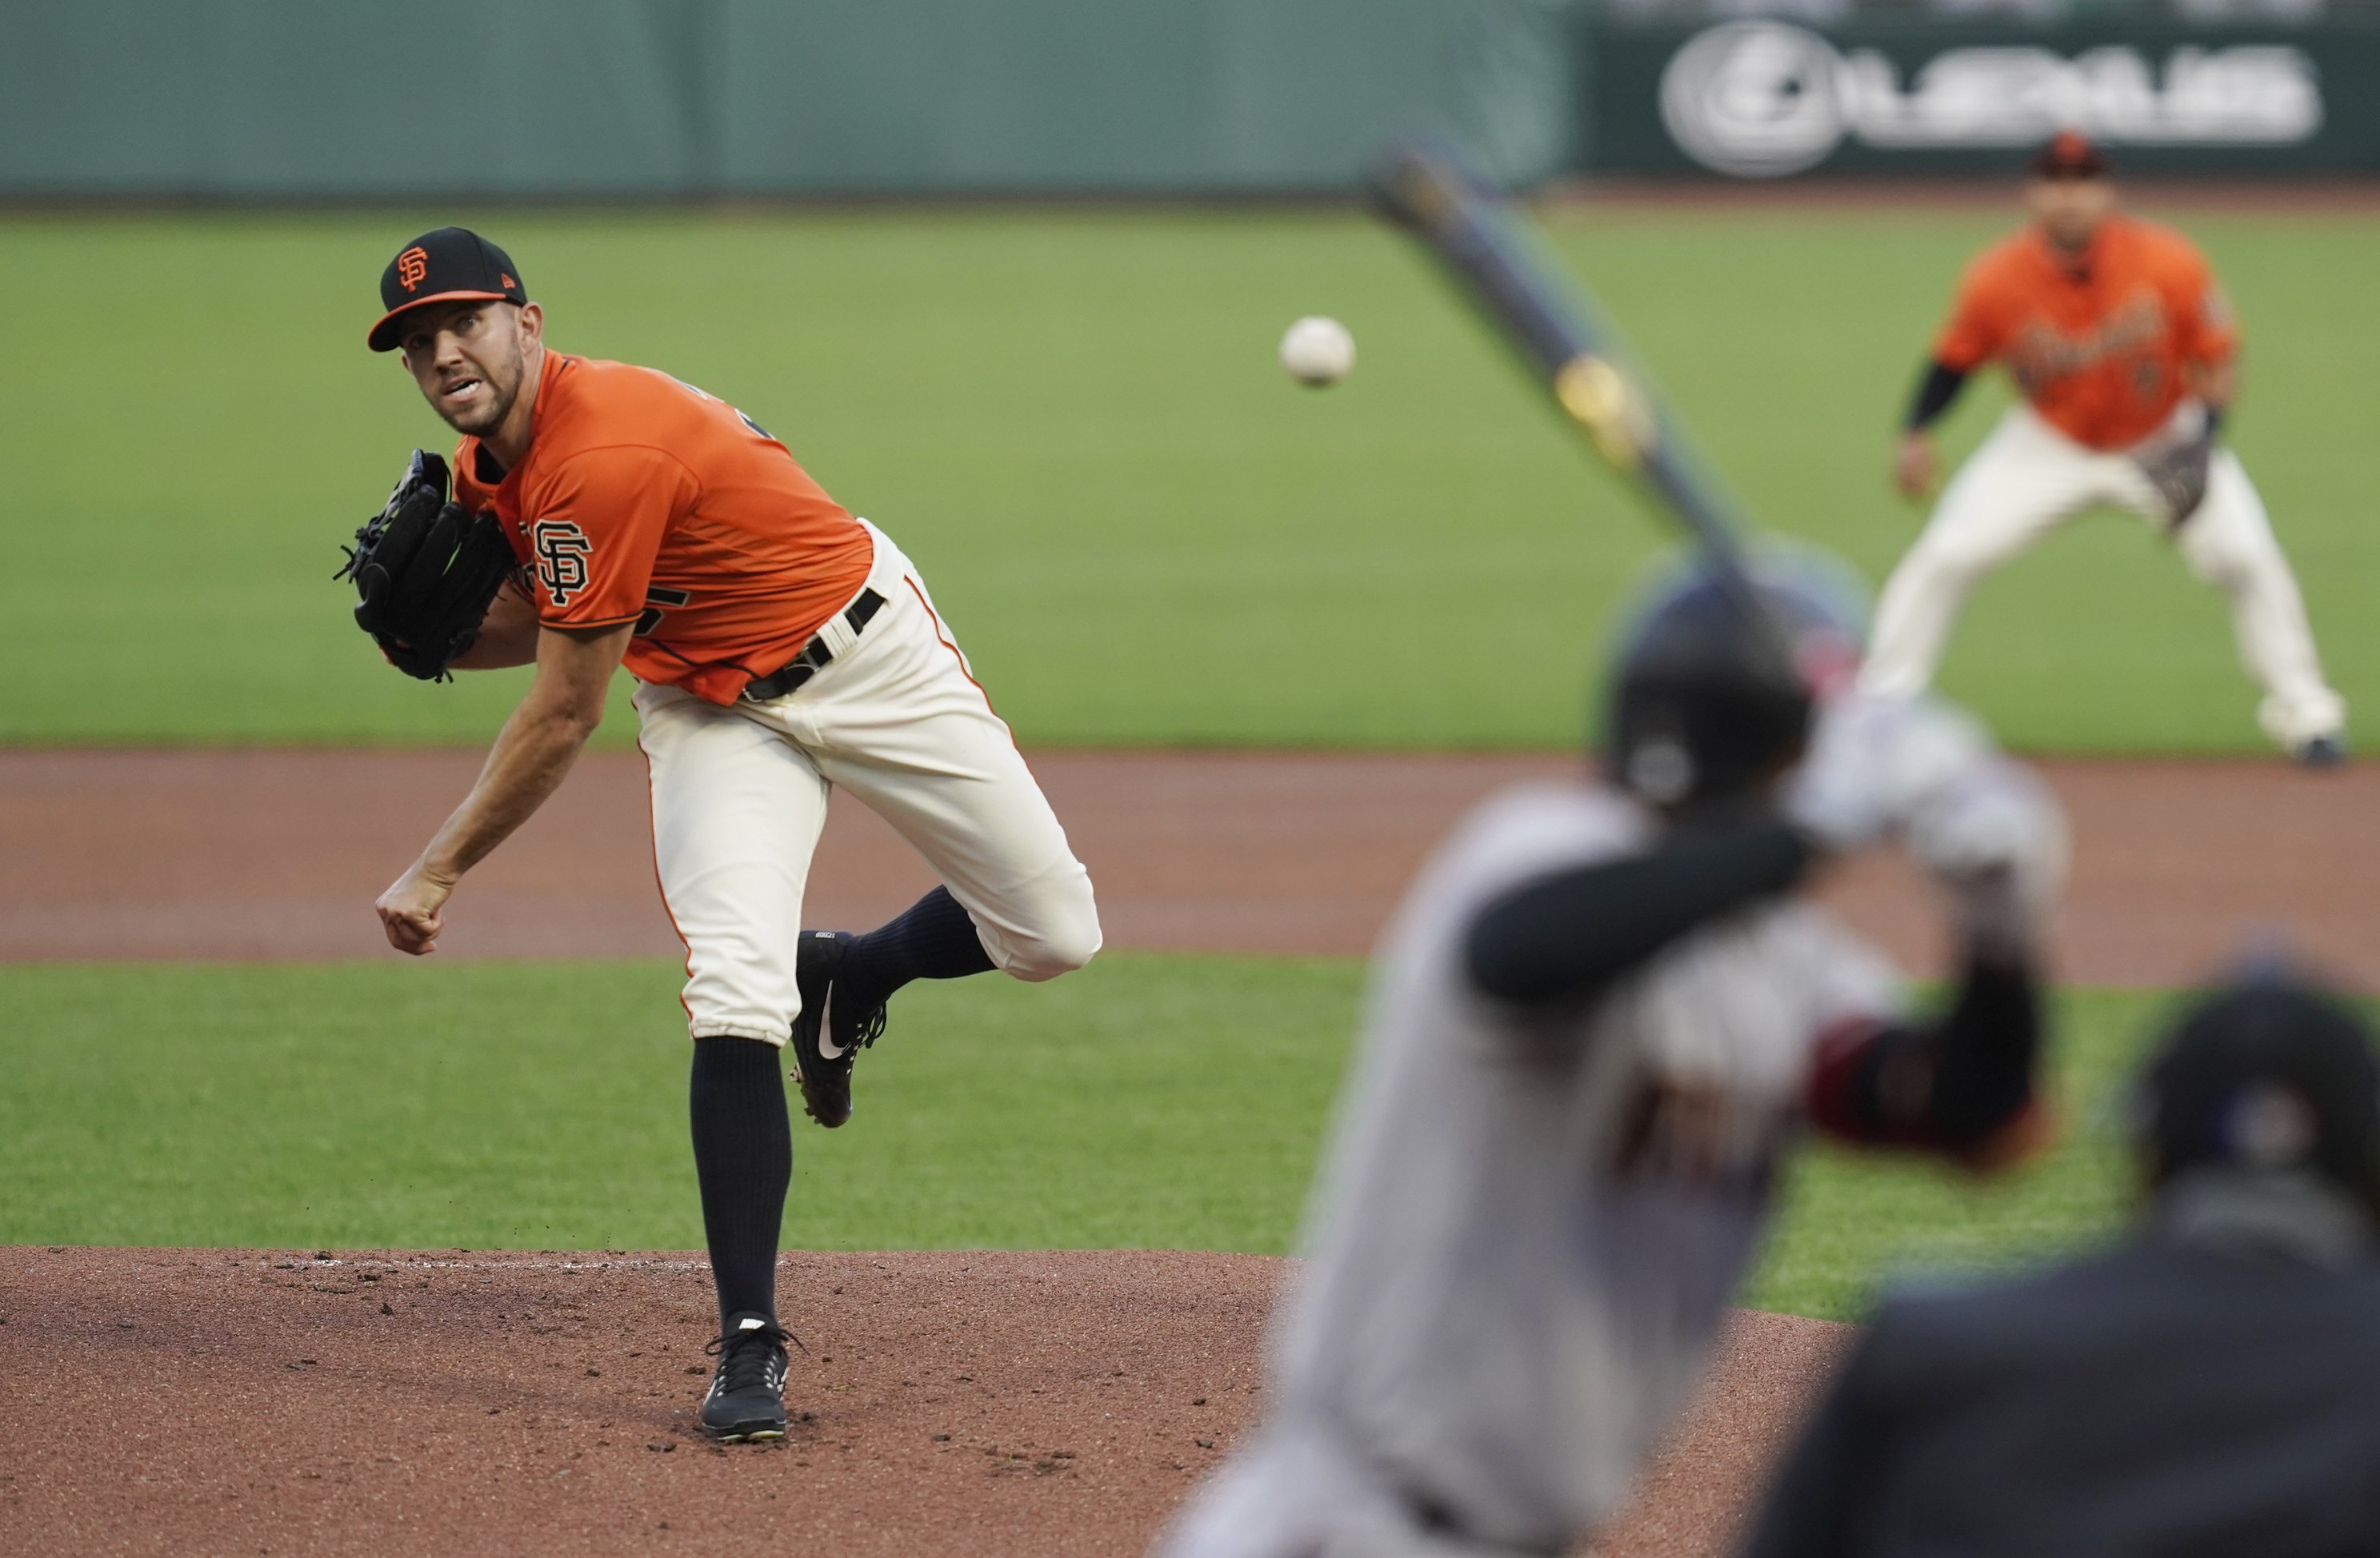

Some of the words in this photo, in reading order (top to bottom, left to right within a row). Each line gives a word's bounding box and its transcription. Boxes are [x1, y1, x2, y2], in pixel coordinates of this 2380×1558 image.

[1843, 44, 2323, 149] LEXUS
[398, 246, 428, 293] SF
[534, 519, 594, 607] SF
